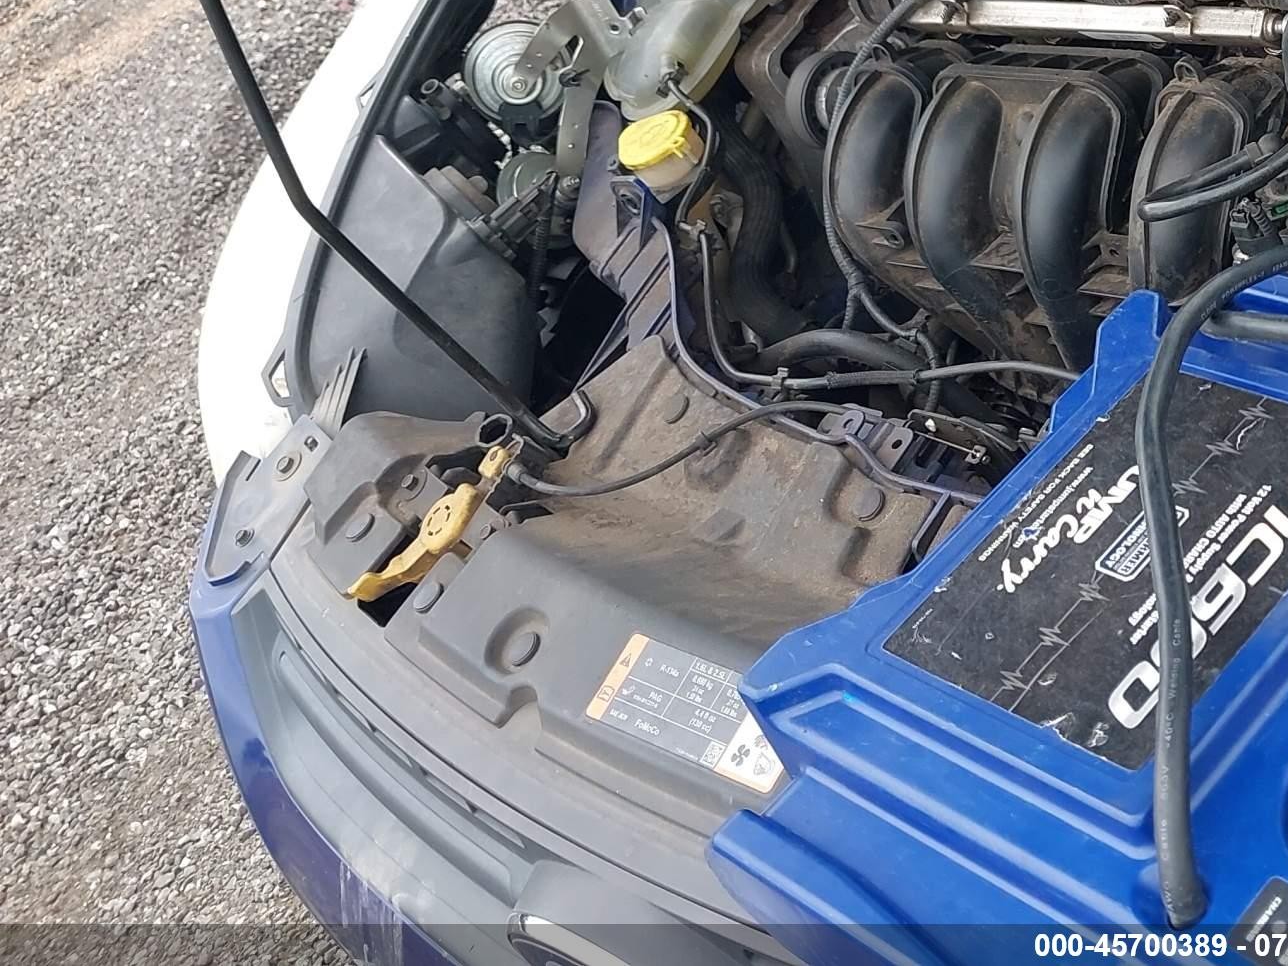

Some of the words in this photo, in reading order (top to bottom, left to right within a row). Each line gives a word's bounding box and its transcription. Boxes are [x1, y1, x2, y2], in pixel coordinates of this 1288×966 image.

[1077, 444, 1094, 462] SEE
[1058, 457, 1081, 479] BACK
[1043, 475, 1061, 494] FOR
[1257, 485, 1271, 499] 12
[1014, 490, 1045, 524] SAFETY
[1067, 465, 1146, 543] UMP
[1225, 491, 1247, 515] with
[1241, 497, 1262, 517] Volt
[1203, 513, 1230, 538] AUTO
[1217, 509, 1247, 543] Power
[978, 517, 1019, 561] WARNINGS
[1189, 537, 1221, 575] Supply
[648, 692, 663, 702] PAG
[634, 719, 660, 735] FoMoCo
